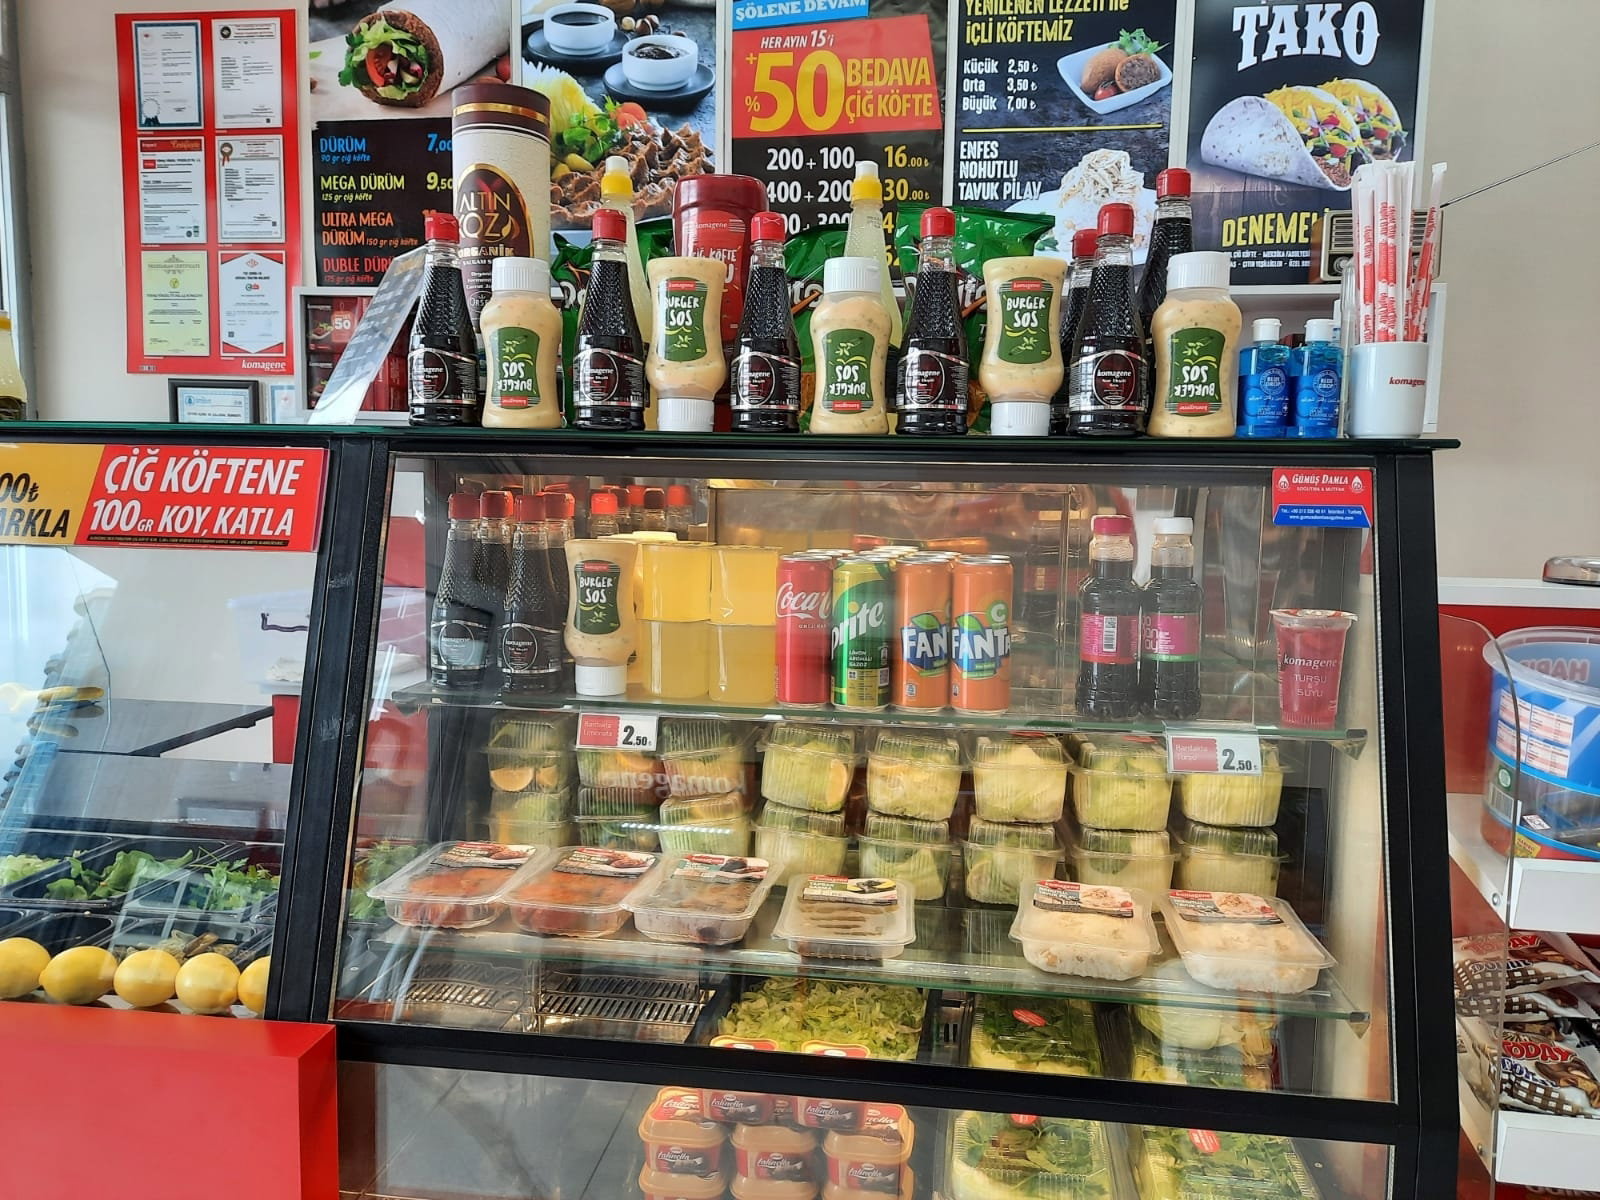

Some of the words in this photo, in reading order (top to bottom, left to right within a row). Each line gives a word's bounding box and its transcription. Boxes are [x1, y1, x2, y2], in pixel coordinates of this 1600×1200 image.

[735, 2, 800, 22] ŞÖLENE
[966, 18, 993, 46] İÇLİ
[996, 16, 1074, 43] KÖFTEMİZ
[1232, 1, 1381, 72] TAKO
[761, 37, 781, 49] HER
[783, 35, 807, 47] AYIN
[847, 56, 931, 88] BEDAVA
[963, 58, 999, 76] Küçük
[1007, 59, 1030, 75] 2,50
[963, 78, 985, 92] Orta
[1007, 79, 1029, 93] 3,50
[846, 93, 873, 123] ÇİĞ
[877, 90, 933, 117] KÖFTE
[962, 96, 997, 115] Büyük
[320, 135, 366, 153] DÜRÜM
[960, 140, 999, 160] ENFES
[321, 154, 330, 162] 90
[332, 155, 340, 164] gr
[352, 153, 371, 162] köfte
[767, 148, 804, 171] 200
[819, 147, 855, 169] 100
[959, 160, 1019, 180] NOHUTLU
[321, 176, 356, 191] MEGA
[361, 173, 405, 191] DÜRÜM
[958, 181, 1000, 201] TAVUK
[322, 193, 332, 201] 125
[334, 194, 342, 202] gr
[355, 193, 373, 201] köfte
[459, 192, 511, 212] ALTIN
[322, 212, 356, 227] ULTRA
[359, 211, 394, 227] MEGA
[322, 230, 366, 247] DÜRÜM
[323, 258, 360, 274] DUBLE
[364, 256, 394, 273] DÜR
[1007, 296, 1046, 311] BURGER
[669, 310, 693, 326] SOS
[1013, 311, 1038, 327] SOS
[242, 360, 286, 371] komagene
[502, 362, 525, 378] SOS
[836, 364, 859, 382] SOS
[1097, 370, 1131, 379] komagene
[1182, 365, 1208, 383] SOS
[496, 378, 532, 391] BURGER
[829, 382, 866, 396] BURGER
[1174, 382, 1215, 397] BURGER
[103, 447, 160, 494] ÇİĞ
[160, 448, 305, 496] KÖFTENE
[1292, 473, 1320, 486] GÜMÜŞ
[1322, 474, 1348, 485] DAMLA
[89, 499, 140, 533] 100
[157, 505, 214, 536] KOY,
[212, 507, 296, 537] KATLA
[580, 576, 613, 588] BURGER
[585, 588, 607, 603] SOS
[832, 601, 884, 660] prite
[1284, 654, 1338, 670] komagene
